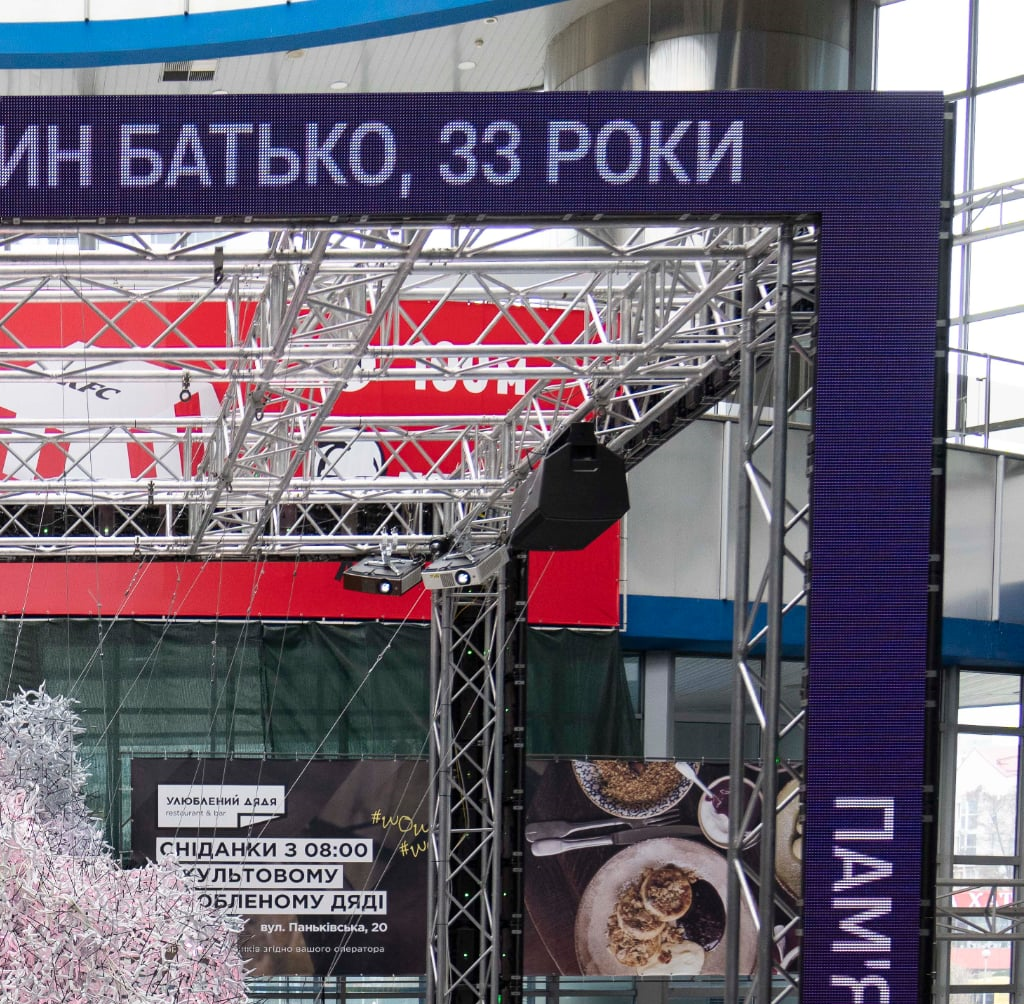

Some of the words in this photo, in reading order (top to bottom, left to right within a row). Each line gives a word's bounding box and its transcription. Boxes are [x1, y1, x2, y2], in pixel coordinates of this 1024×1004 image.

[118, 121, 412, 198] БАТЬКО,
[438, 120, 522, 186] 33
[546, 120, 744, 186] РОКИ
[166, 794, 240, 806] УЛЮБЛЕНИЙ
[165, 809, 204, 817] restaurant
[213, 809, 227, 817] bar
[159, 841, 277, 859] СНІДАНКИ
[304, 842, 368, 858] 08:00
[330, 894, 384, 912] ДЯДІ
[260, 924, 285, 934] вул.
[288, 922, 368, 935] Паньківська,
[370, 922, 388, 933] 20
[263, 944, 293, 955] згідно
[295, 945, 331, 954] вашого
[333, 945, 385, 955] оператора
